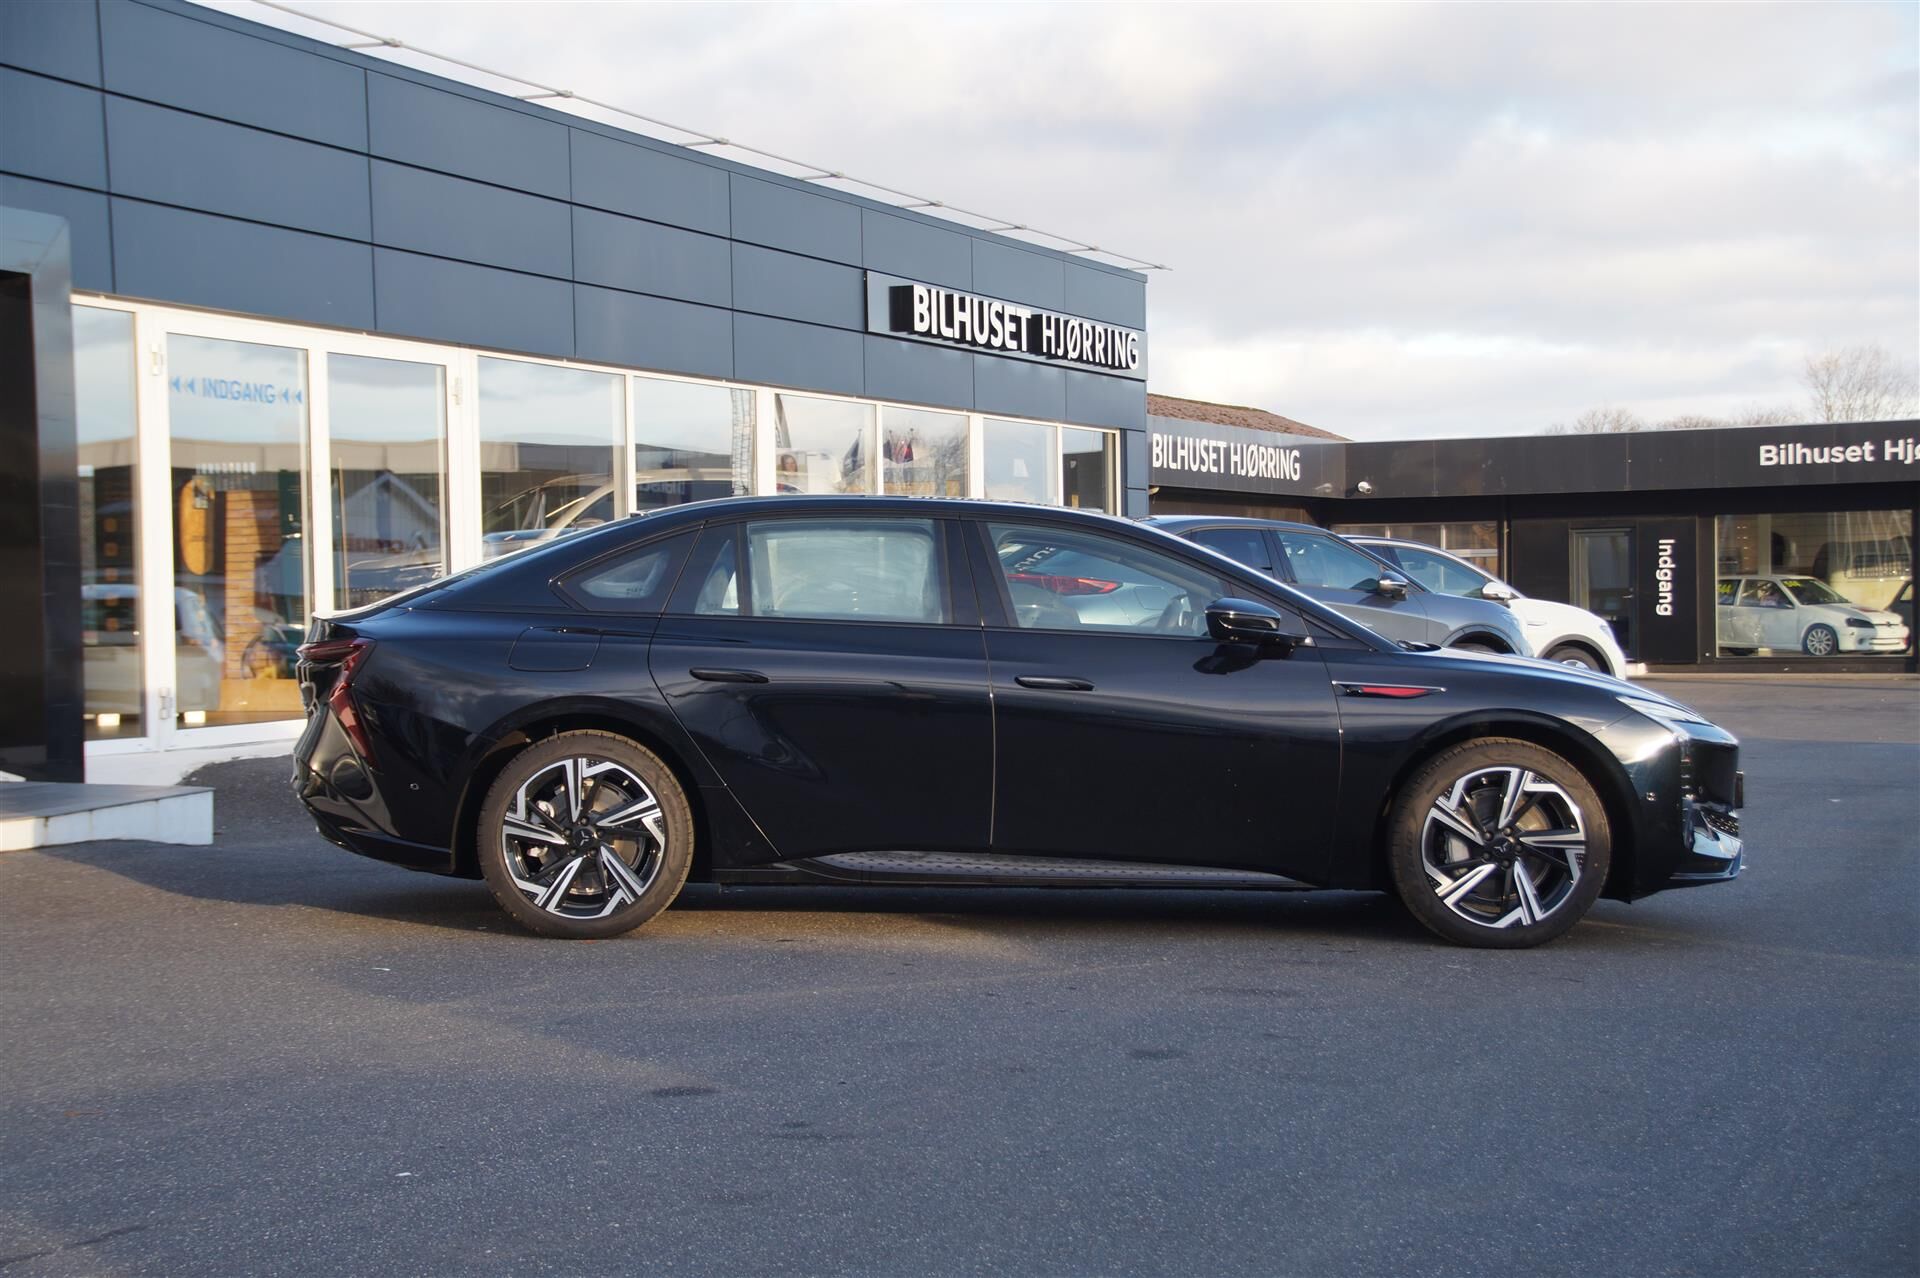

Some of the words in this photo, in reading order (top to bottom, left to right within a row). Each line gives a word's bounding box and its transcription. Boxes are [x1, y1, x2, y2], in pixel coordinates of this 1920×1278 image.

[913, 284, 1031, 352] BILHUSET
[1042, 312, 1139, 370] HJØRRING
[202, 378, 276, 404] INDGANG
[1152, 433, 1227, 474] BILHUSET
[1230, 442, 1301, 481] HJØRRING
[1759, 441, 1875, 466] Bilhuset
[1655, 539, 1677, 616] Indgang
